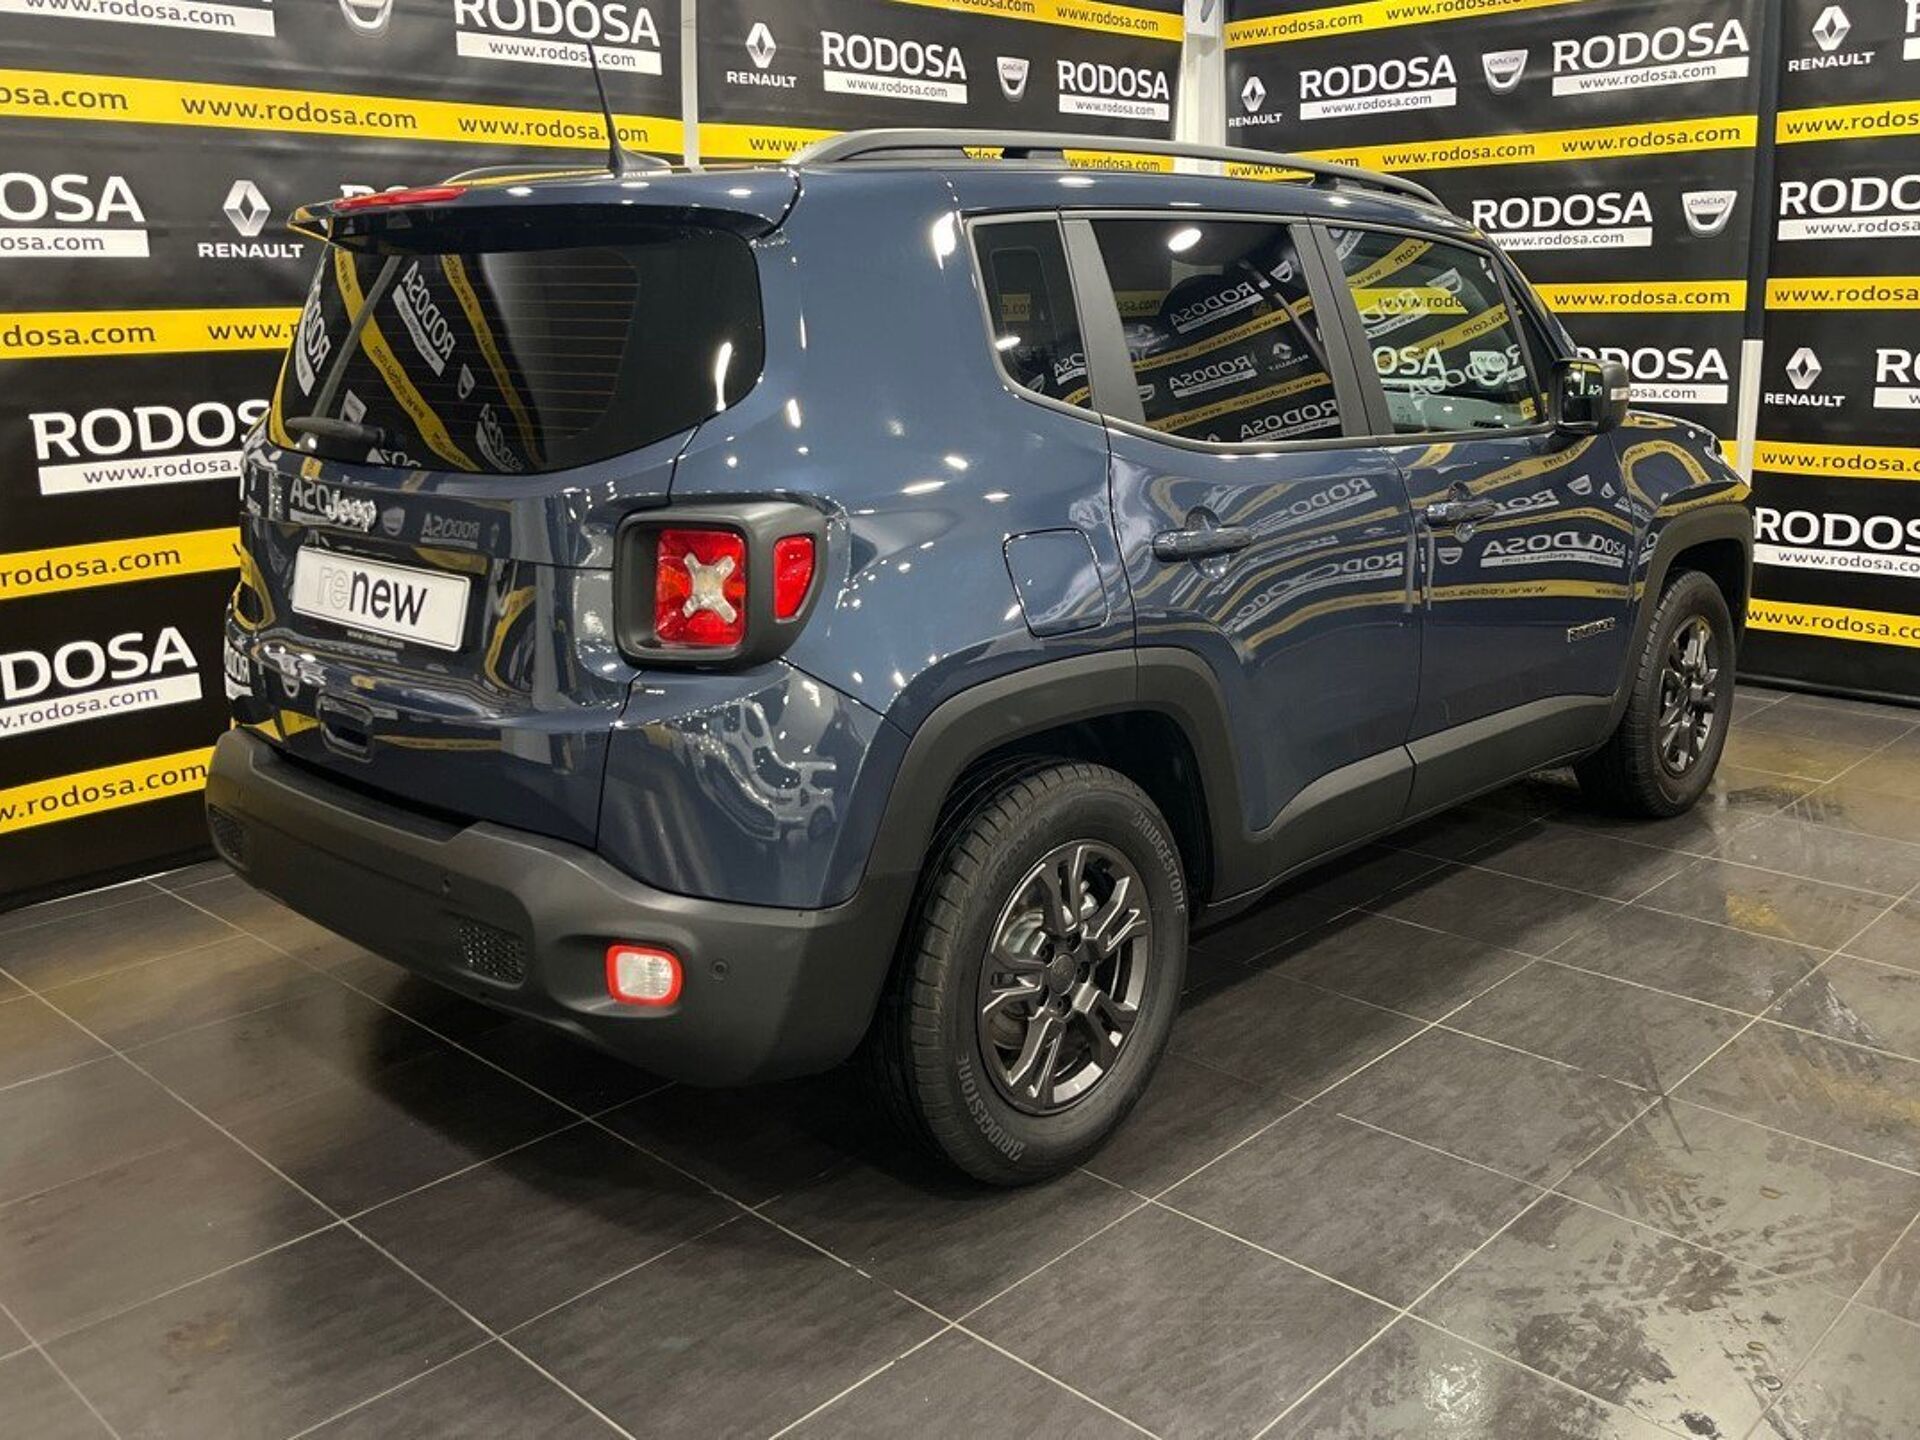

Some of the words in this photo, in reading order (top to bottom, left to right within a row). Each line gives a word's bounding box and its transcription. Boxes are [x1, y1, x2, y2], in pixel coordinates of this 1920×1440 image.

[455, 0, 661, 47] RODOSA
[1056, 7, 1159, 31] www.rodosa.com
[1229, 13, 1363, 42] www.rodosa.com
[820, 31, 967, 80] RODOSA
[1552, 18, 1750, 72] RODOSA
[1788, 51, 1875, 72] RENAULT
[726, 71, 797, 88] RENAULT
[846, 80, 949, 98] www.rodosa.com
[1057, 60, 1170, 100] RODOSA
[1300, 54, 1457, 99] RODOSA
[1579, 64, 1717, 89] www.rodosa.com
[181, 97, 419, 130] www.rodosa.com
[458, 118, 648, 143] www.rodosa.om
[1075, 100, 1155, 117] www.rodosa.com
[1229, 113, 1283, 127] RENAULT
[1321, 93, 1432, 114] www.rodosa.com
[1382, 143, 1535, 166] www.rodosa.com
[1562, 127, 1741, 153] www.rodosa.com
[0, 172, 146, 222] OSA
[1472, 191, 1653, 229] RODOSA
[197, 243, 304, 259] RENAULT
[1554, 288, 1730, 306] www.rodosa.com
[3, 324, 155, 347] dosa.com
[1764, 392, 1845, 407] RENAULT
[29, 399, 269, 461] RODOS
[326, 490, 377, 533] Jeep
[317, 566, 428, 626] renew
[0, 626, 197, 700] DOSA
